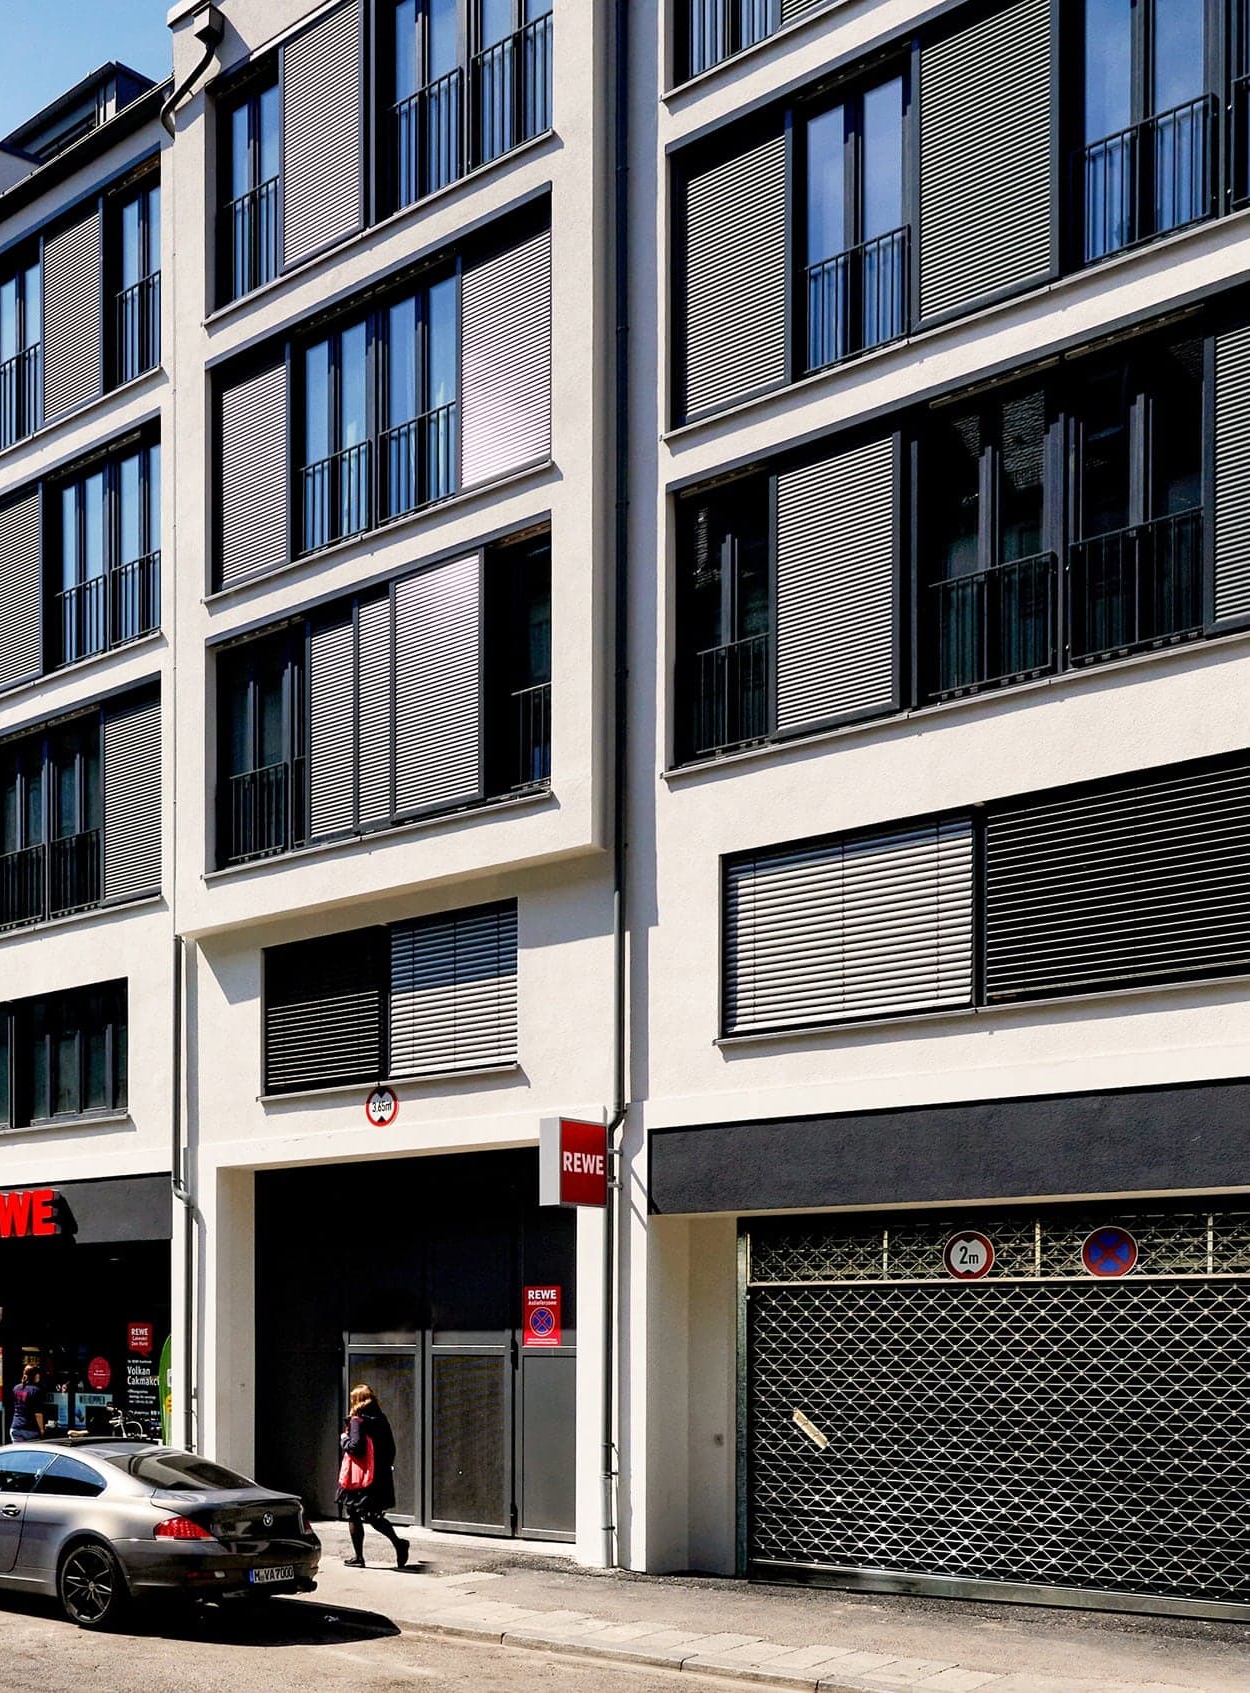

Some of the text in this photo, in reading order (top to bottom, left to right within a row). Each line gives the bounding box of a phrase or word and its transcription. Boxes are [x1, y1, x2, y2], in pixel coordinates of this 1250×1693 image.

[563, 1151, 604, 1175] REWE
[960, 1246, 979, 1264] 2m
[528, 1290, 557, 1300] REWE
[131, 1328, 149, 1336] REWE
[127, 1365, 150, 1375] Volkan
